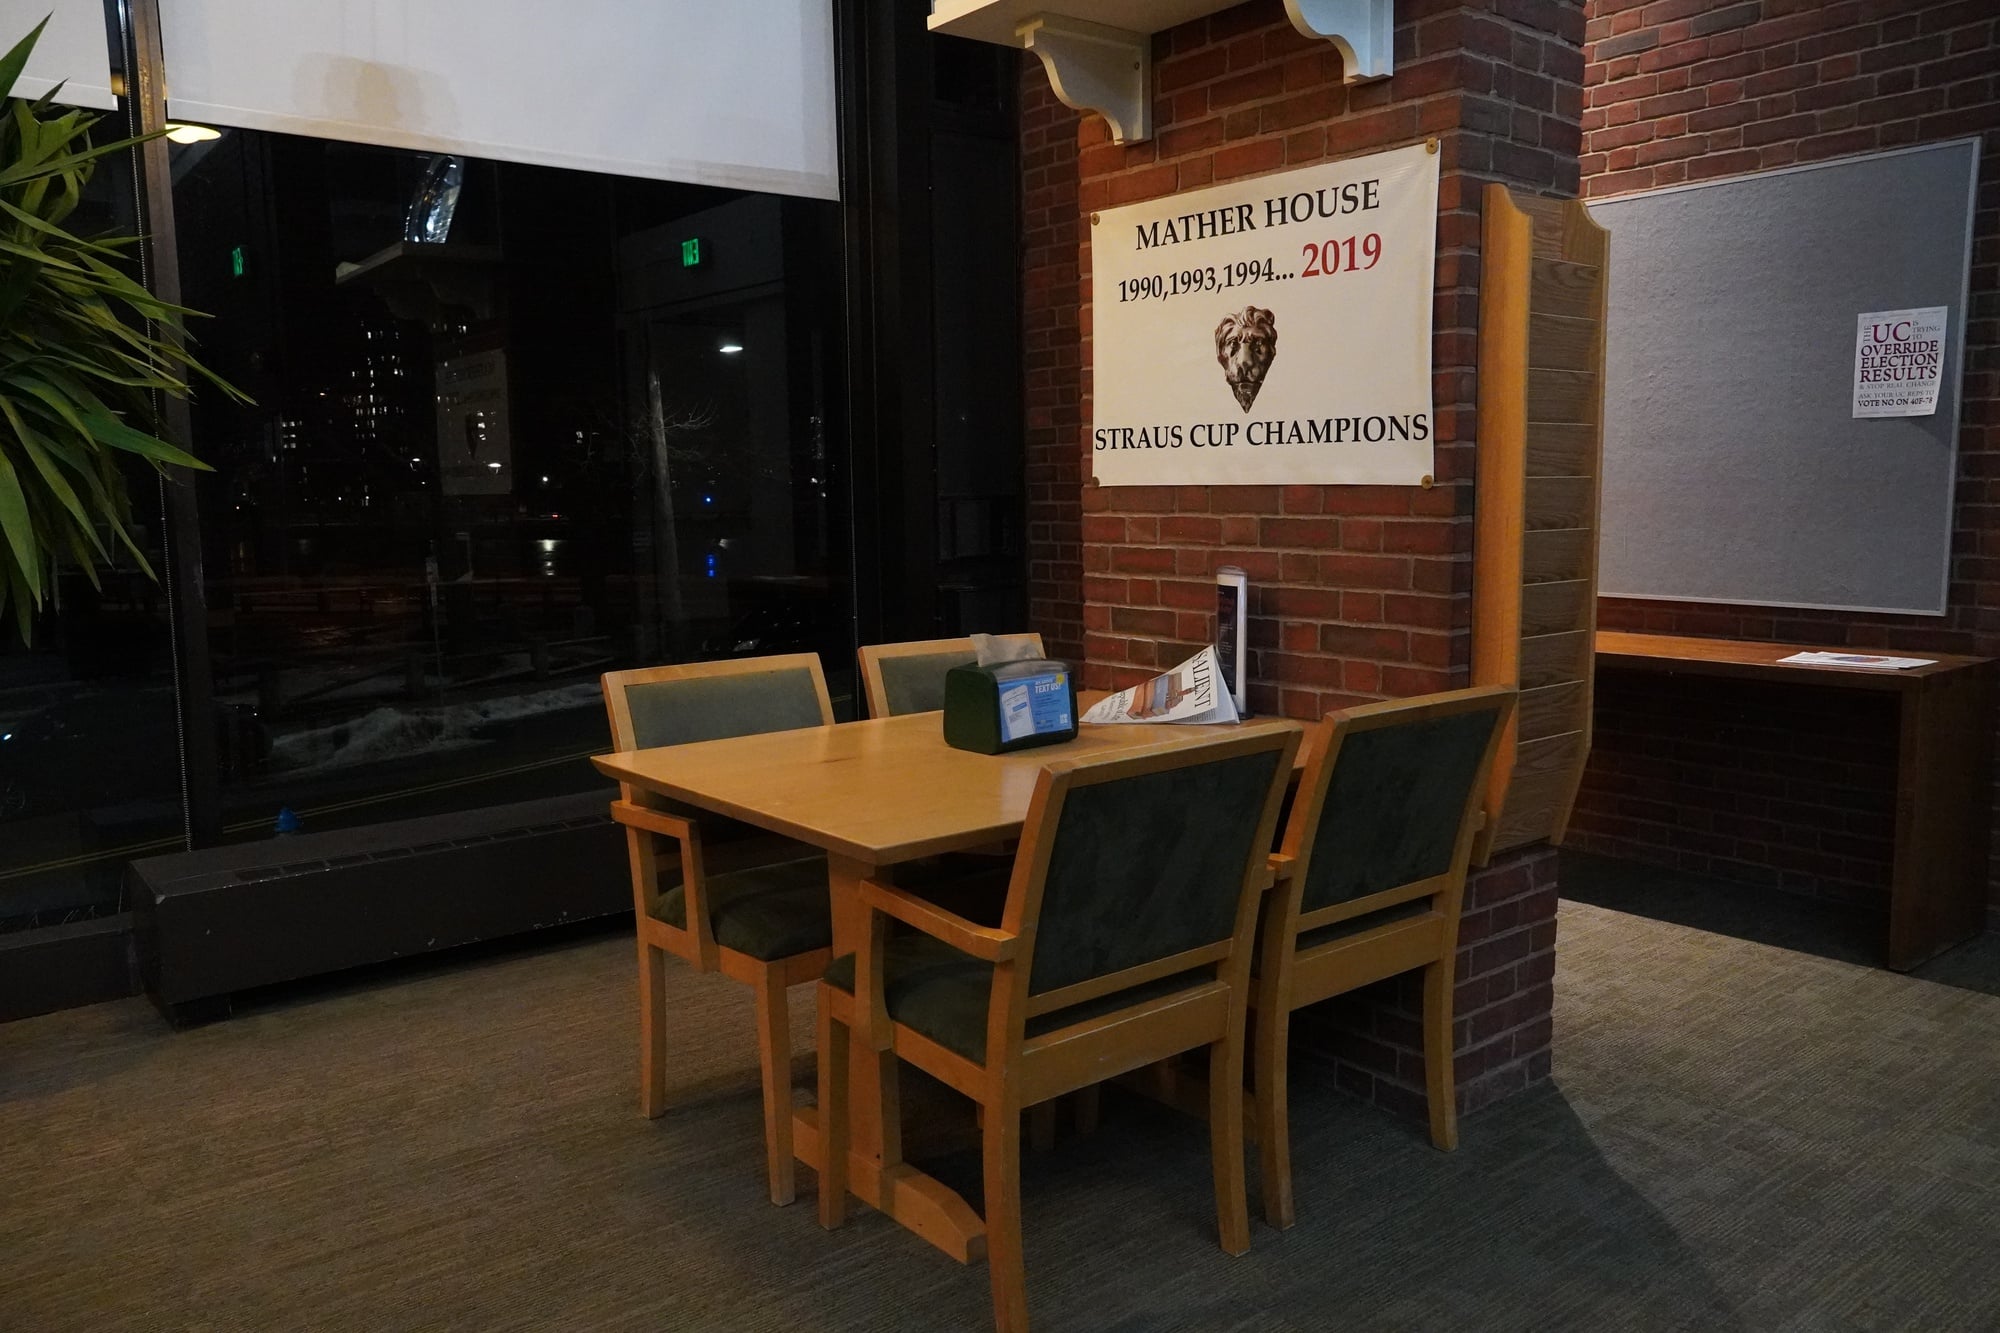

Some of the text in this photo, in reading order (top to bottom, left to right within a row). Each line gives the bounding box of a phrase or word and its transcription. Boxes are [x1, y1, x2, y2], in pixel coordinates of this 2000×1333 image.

[1135, 179, 1380, 251] MATHER HOUSE
[1118, 232, 1382, 303] 1990,1993,1994... 2019
[1872, 321, 1911, 344] UC
[1912, 326, 1940, 334] TRYING
[1861, 340, 1939, 357] OVERRIDE
[1861, 353, 1939, 369] ELECTION
[1859, 365, 1938, 383] RESULTS
[1906, 380, 1935, 388] CHANGE
[1874, 391, 1894, 399] YOUR
[1882, 398, 1894, 406] NO
[1896, 398, 1909, 406] ON
[1094, 414, 1429, 451] STRAUS CUP CHAMPIONS
[1192, 650, 1211, 708] SALIENT
[1034, 684, 1050, 694] TEXT
